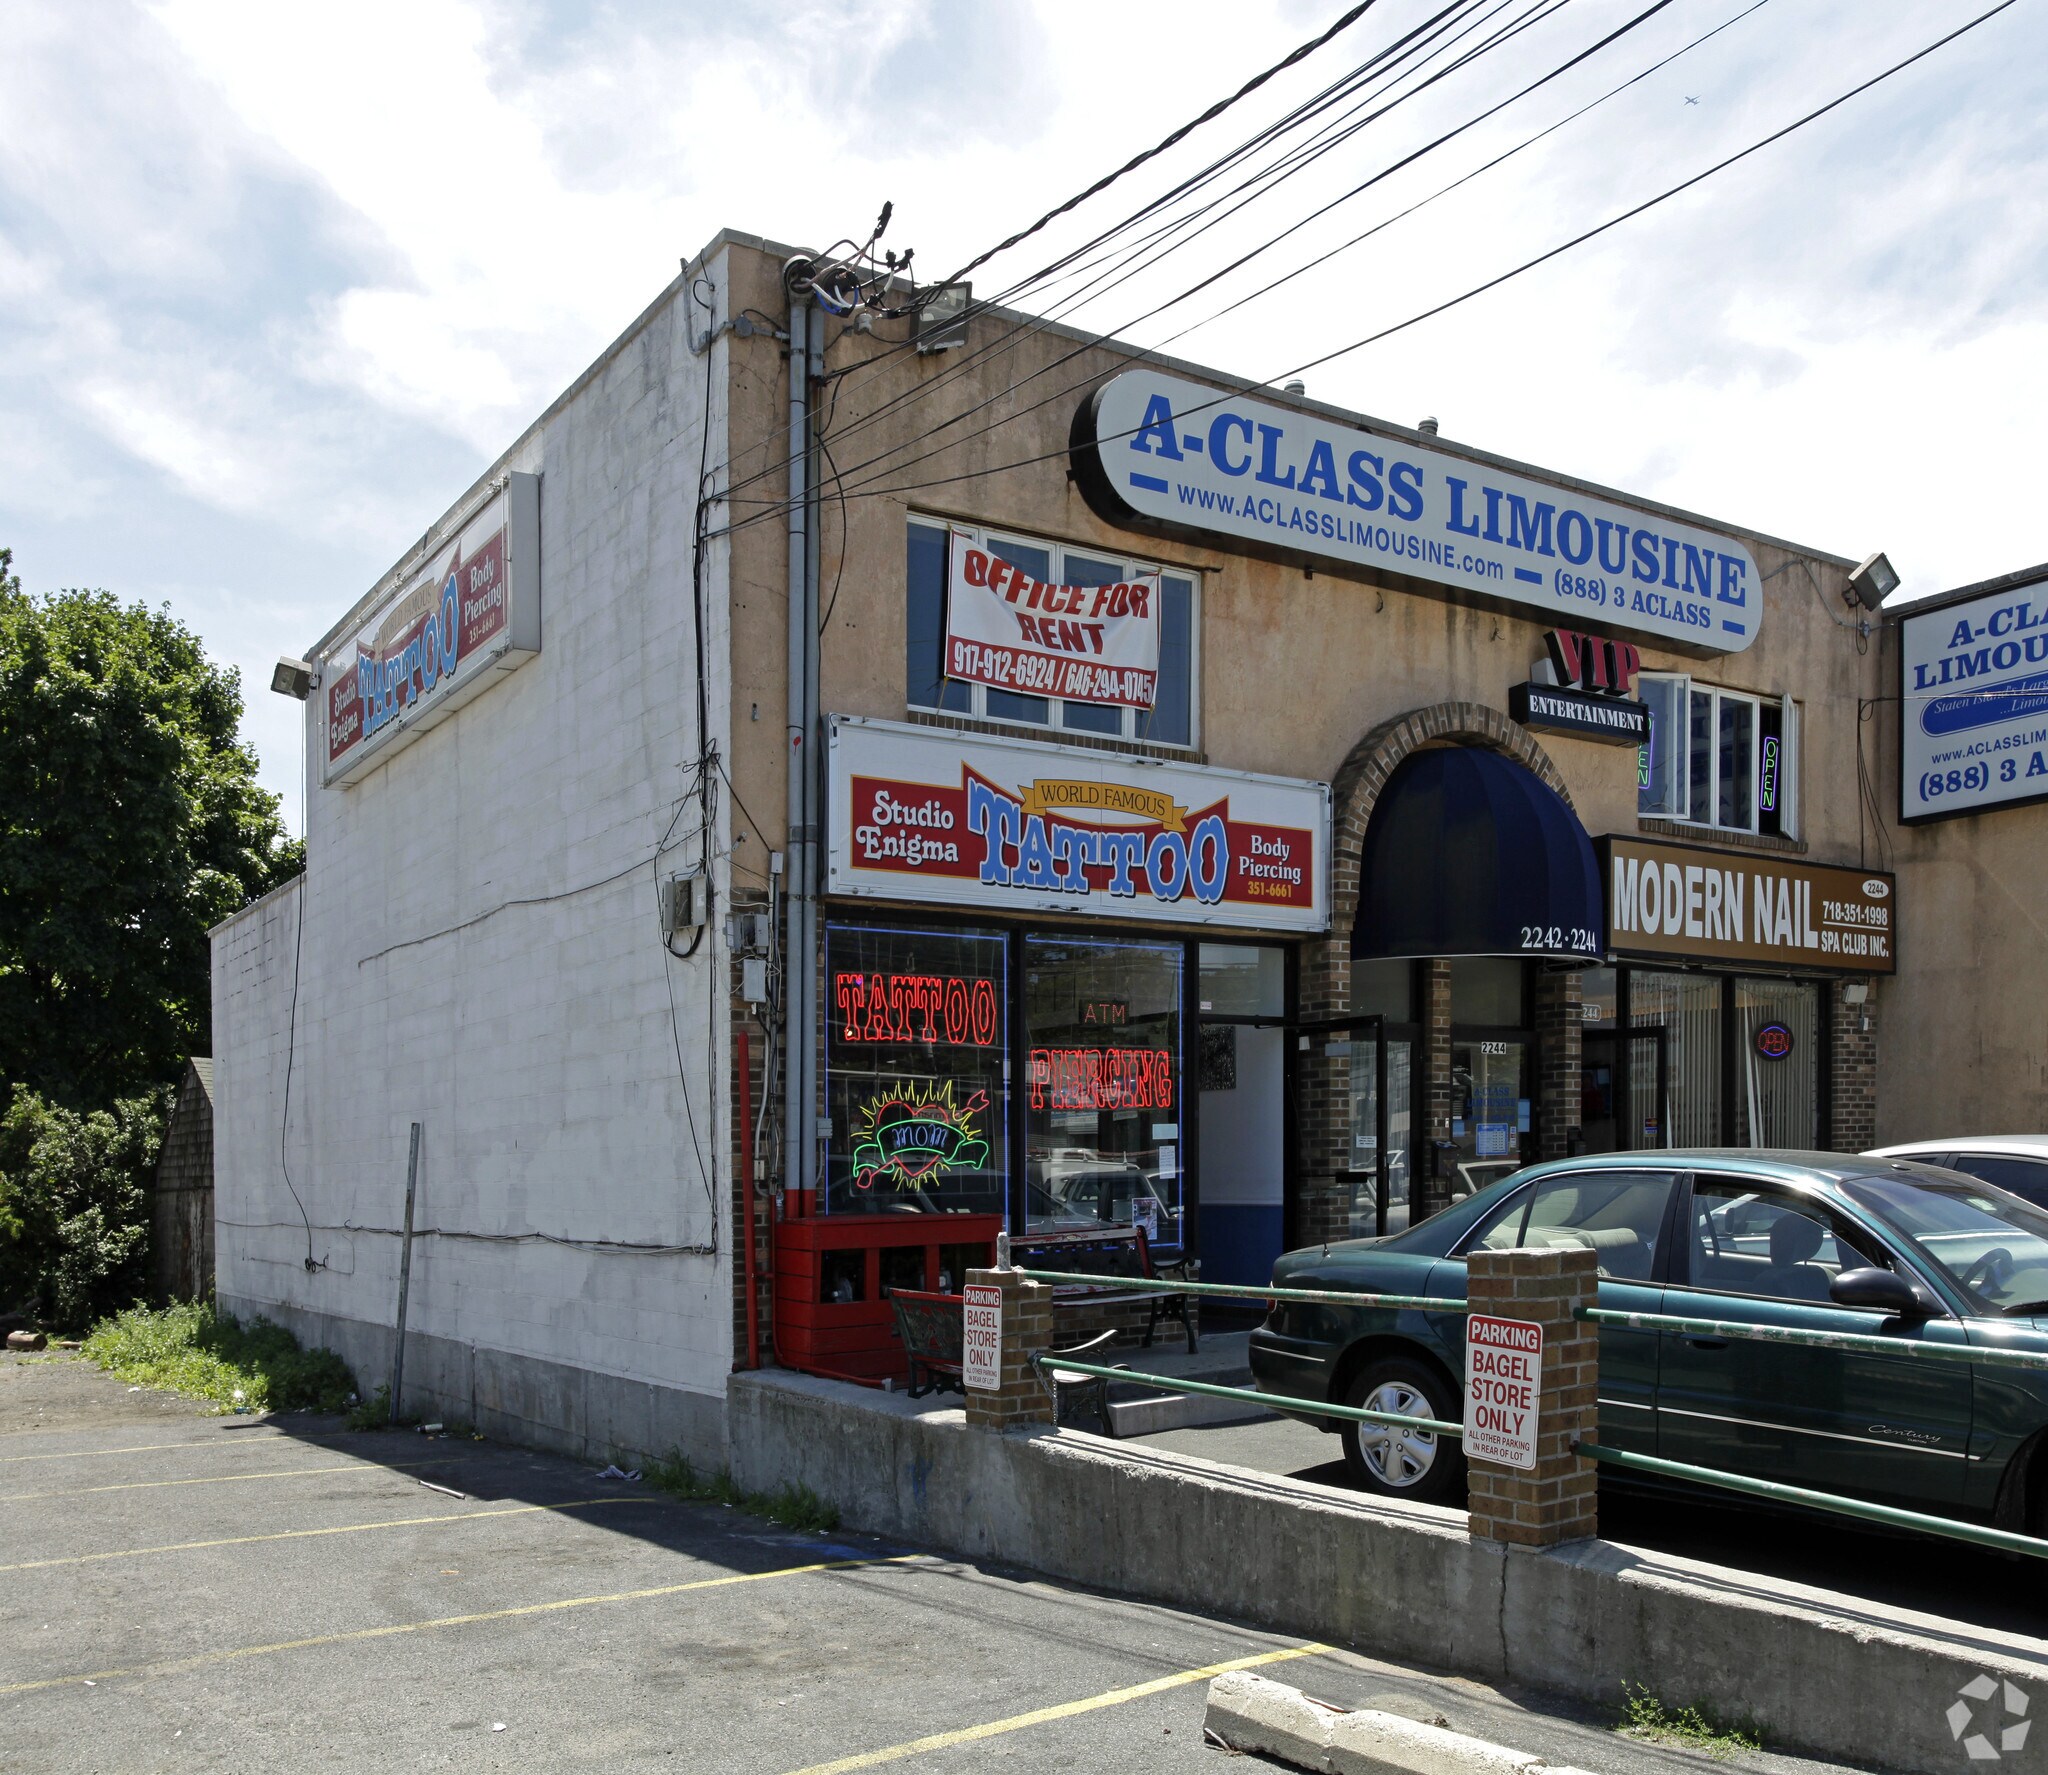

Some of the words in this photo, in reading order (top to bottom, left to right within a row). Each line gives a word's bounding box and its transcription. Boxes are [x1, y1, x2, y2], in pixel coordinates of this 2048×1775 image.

[1130, 394, 1423, 521] A-CLASS
[1446, 476, 1746, 607] LIMOUSINE
[1177, 484, 1504, 580] www.ACLASSLIMOUSINE.com
[1555, 568, 1606, 605] (888)
[1614, 586, 1625, 607] 3
[1631, 591, 1711, 629] ACLASS
[470, 554, 494, 594] Body
[964, 550, 1085, 614] OFFICE
[1088, 582, 1149, 619] FOR
[464, 581, 502, 627] Piercing
[1015, 611, 1105, 655] RENT
[358, 572, 459, 741] TATTOO
[954, 641, 1054, 691] 917-912-6924
[1065, 663, 1152, 704] 646-294-0745
[1548, 628, 1640, 693] VIP
[1914, 633, 2048, 690] LIMOU
[334, 678, 356, 718] Studio
[1529, 694, 1643, 732] ENTERTAINMENT
[1934, 697, 1969, 714] Staten
[331, 710, 359, 750] Enigma
[1932, 729, 2047, 764] www.ACLASSLIM
[1762, 741, 1777, 807] OPEN
[1919, 762, 1989, 802] (888)
[2000, 758, 2016, 782] 3
[2025, 751, 2048, 777] A
[872, 790, 954, 829] Studio
[1041, 784, 1099, 804] WORLD
[1104, 788, 1165, 816] FAMOUS
[856, 825, 959, 865] Enigma
[967, 776, 1230, 904] TATTOO
[1251, 835, 1290, 861] Body
[1239, 856, 1301, 885] Piercing
[1248, 881, 1292, 898] 351-6661
[1614, 855, 1744, 942] MODERN
[1754, 874, 1818, 948] NAIL
[1868, 883, 1884, 895] 2244
[1823, 901, 1888, 926] 718-351-1998
[1821, 930, 1840, 953] SPA
[1842, 932, 1867, 956] CLUB
[1870, 935, 1889, 957] INC.
[837, 974, 996, 1044] TATTOO
[1084, 1003, 1126, 1025] ATM
[1482, 1043, 1505, 1054] 2244
[1758, 1031, 1790, 1052] OPEN
[1030, 1049, 1173, 1110] PIERCING
[966, 1290, 999, 1306] PARKING
[967, 1309, 998, 1328] BAGEL
[967, 1329, 997, 1348] STORE
[1471, 1321, 1538, 1350] PARKING
[969, 1349, 994, 1367] ONLY
[983, 1369, 997, 1377] PARKING
[1472, 1350, 1533, 1382] BAGEL
[1471, 1377, 1532, 1410] STORE
[1475, 1405, 1524, 1436] ONLY
[1868, 1424, 1941, 1443] Century
[1469, 1430, 1479, 1440] ALL
[1480, 1432, 1501, 1445] OTHER
[1502, 1437, 1530, 1451] PARKING
[1473, 1442, 1480, 1451] IN
[1481, 1443, 1498, 1455] REAR
[1500, 1448, 1509, 1458] OF
[1510, 1450, 1524, 1461] LOT
